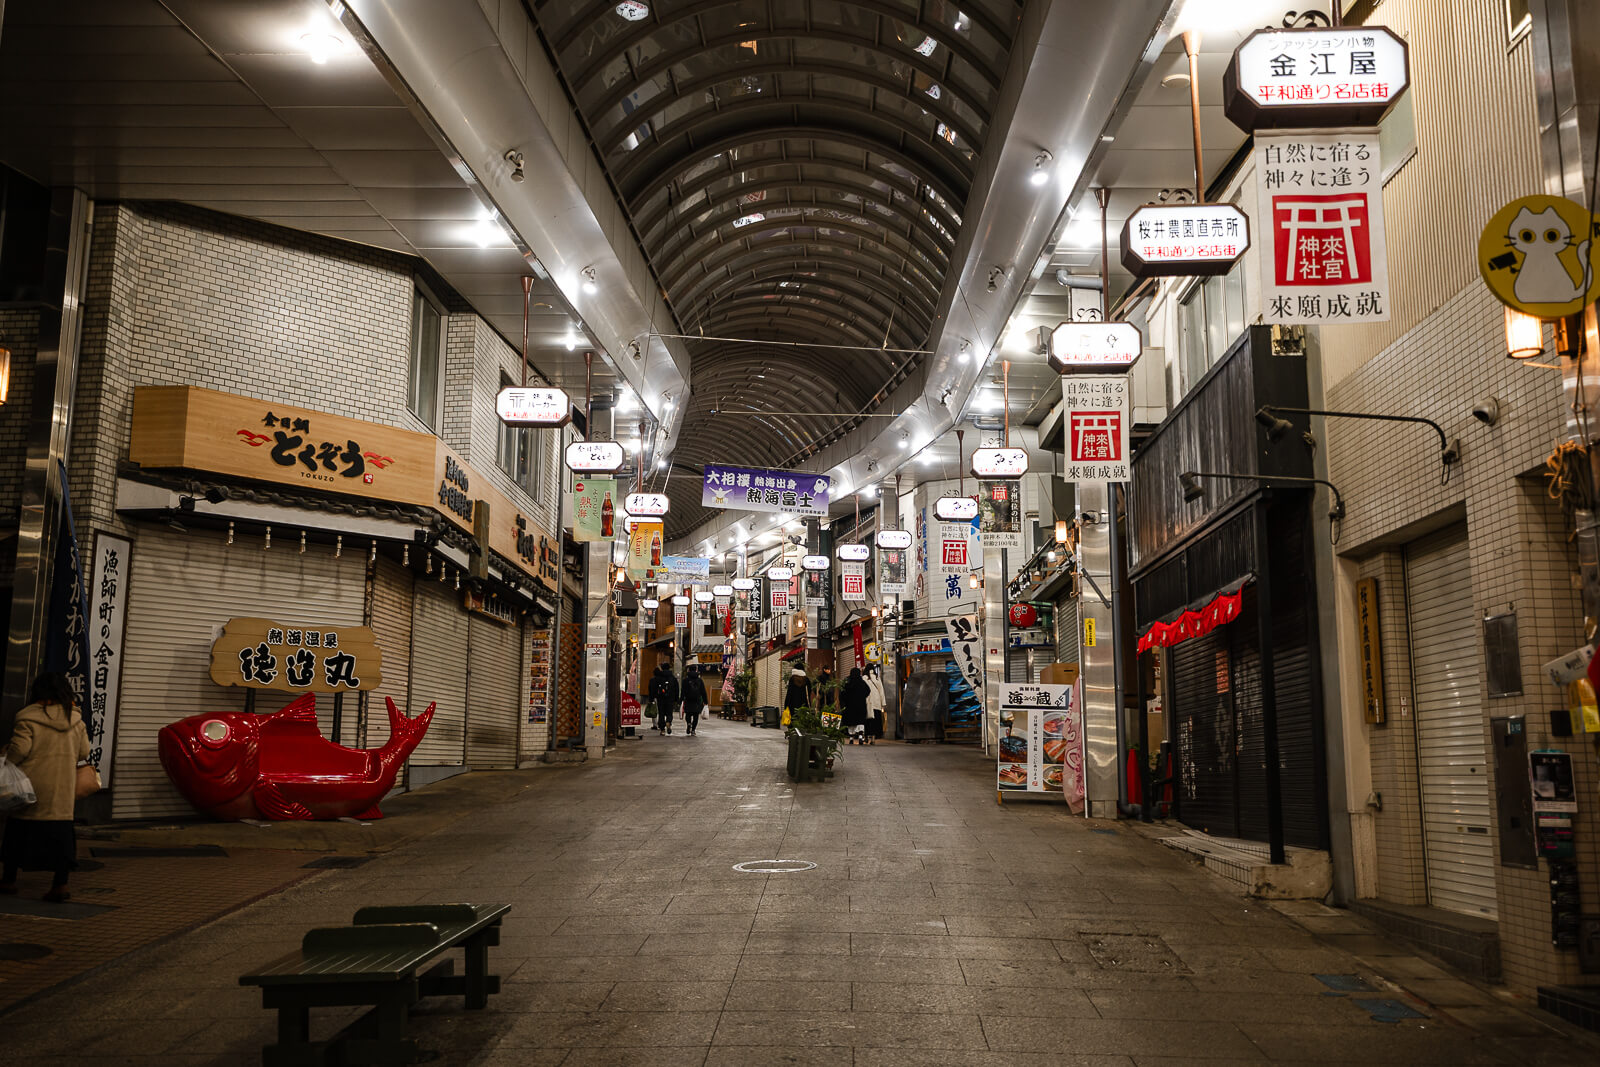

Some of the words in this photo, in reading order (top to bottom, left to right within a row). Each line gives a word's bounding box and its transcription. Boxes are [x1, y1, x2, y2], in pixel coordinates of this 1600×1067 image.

[1269, 51, 1377, 77] 金江屋
[1258, 82, 1389, 101] 平和通り名店街
[1264, 142, 1372, 166] 自然に宿る
[1264, 166, 1372, 190] 神々に逢う
[1138, 217, 1239, 239] 桜井農園直売所
[1142, 244, 1237, 260] 平和通り名店街
[1298, 235, 1322, 281] 神社
[1321, 235, 1345, 280] 來宮
[1270, 291, 1384, 319] 來願成就
[1066, 382, 1124, 395] 自然に宿る
[1066, 395, 1124, 408] 神々に逢う
[261, 411, 310, 435] 金目鯛
[270, 430, 366, 479] とくぞう
[1083, 433, 1096, 460] 神社
[300, 471, 335, 483] TOKUZO
[706, 469, 752, 488] 大相撲
[754, 475, 798, 490] 熱海出身
[1067, 465, 1127, 480] 來願成就
[746, 486, 815, 509] 熱海富士
[268, 627, 339, 649] 熱海温泉
[88, 547, 120, 774] 漁師町の金目鯛料理
[239, 641, 361, 688] 徳造丸
[1054, 695, 1065, 707] 2F
